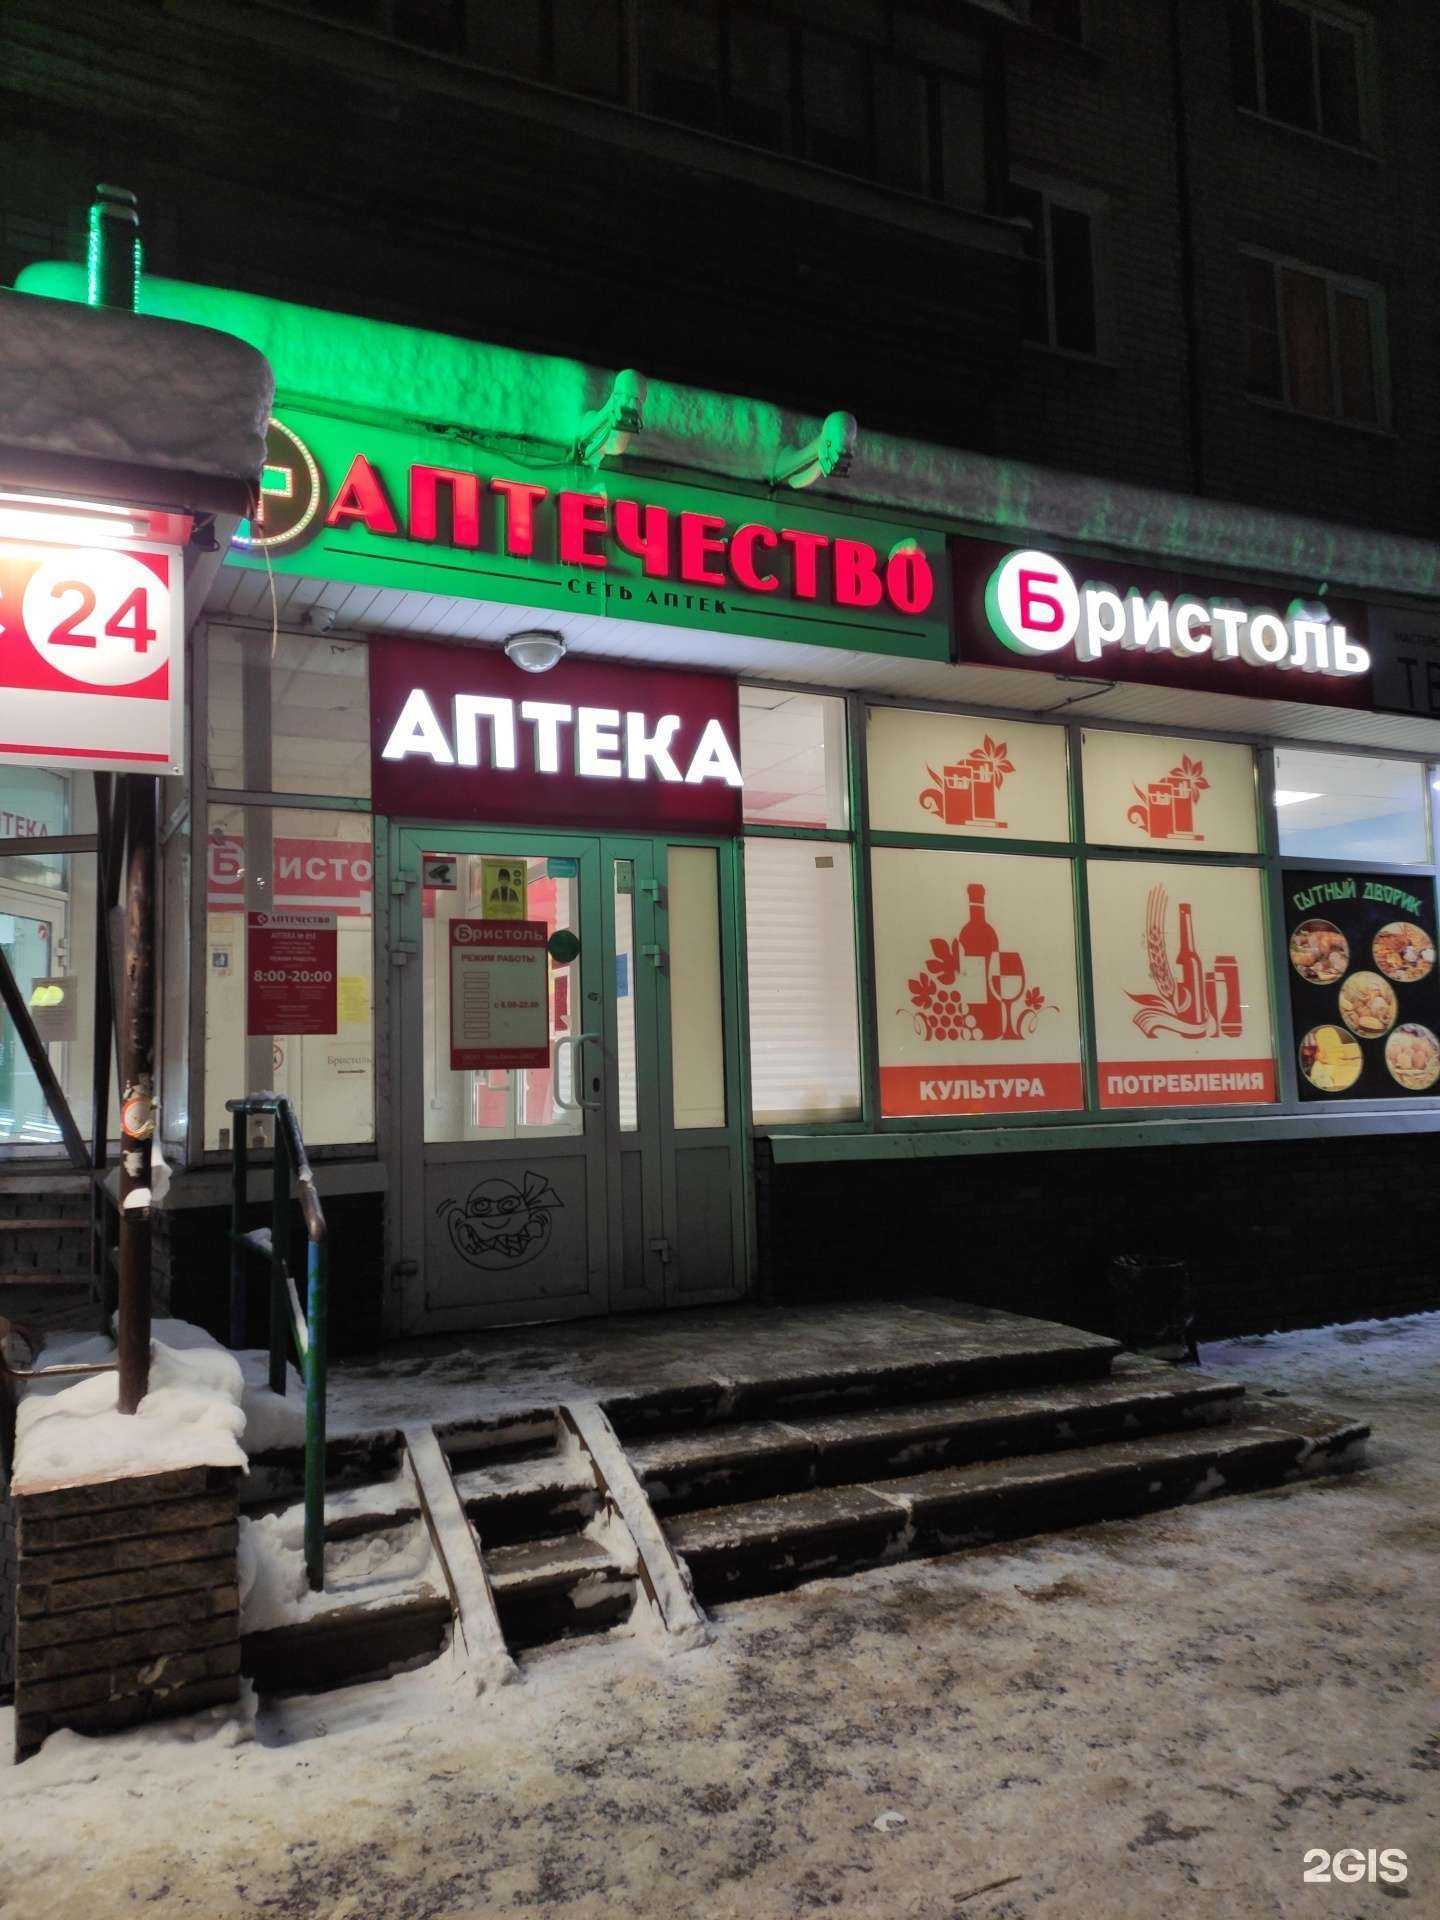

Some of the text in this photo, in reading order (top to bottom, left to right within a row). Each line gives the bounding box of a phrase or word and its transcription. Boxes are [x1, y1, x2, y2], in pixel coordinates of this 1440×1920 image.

[326, 454, 934, 615] АПТЕЧЕСТВО
[48, 580, 156, 653] 24
[567, 579, 727, 614] СЕТЬ АПТЕК
[1000, 552, 1371, 674] Бристоль
[381, 688, 744, 786] АПТЕКА
[1293, 879, 1422, 916] СЫТНЫЙ ДВОРИК
[253, 969, 333, 983] 8:00-20:00
[919, 1072, 1265, 1101] КУЛЬТУРА ПОТРЕБЛЕНИЯ
